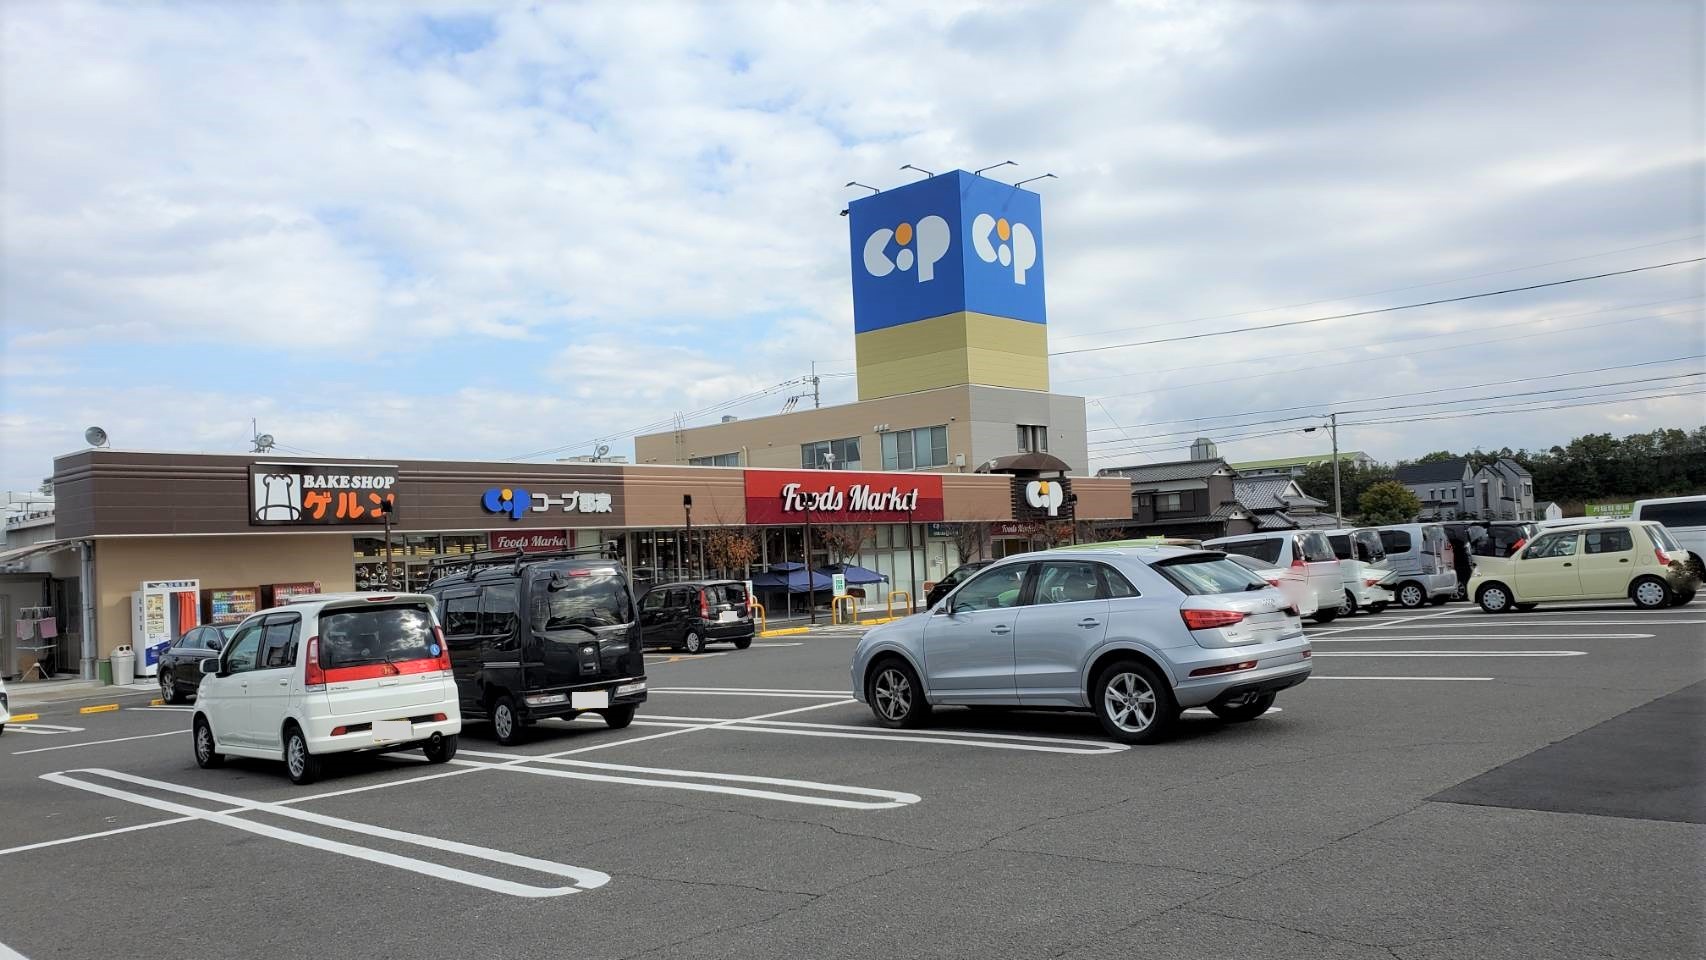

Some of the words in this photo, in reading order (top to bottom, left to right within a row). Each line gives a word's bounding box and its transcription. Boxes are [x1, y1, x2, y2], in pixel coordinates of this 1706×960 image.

[303, 490, 395, 520] ゲルン
[497, 536, 528, 548] Foods
